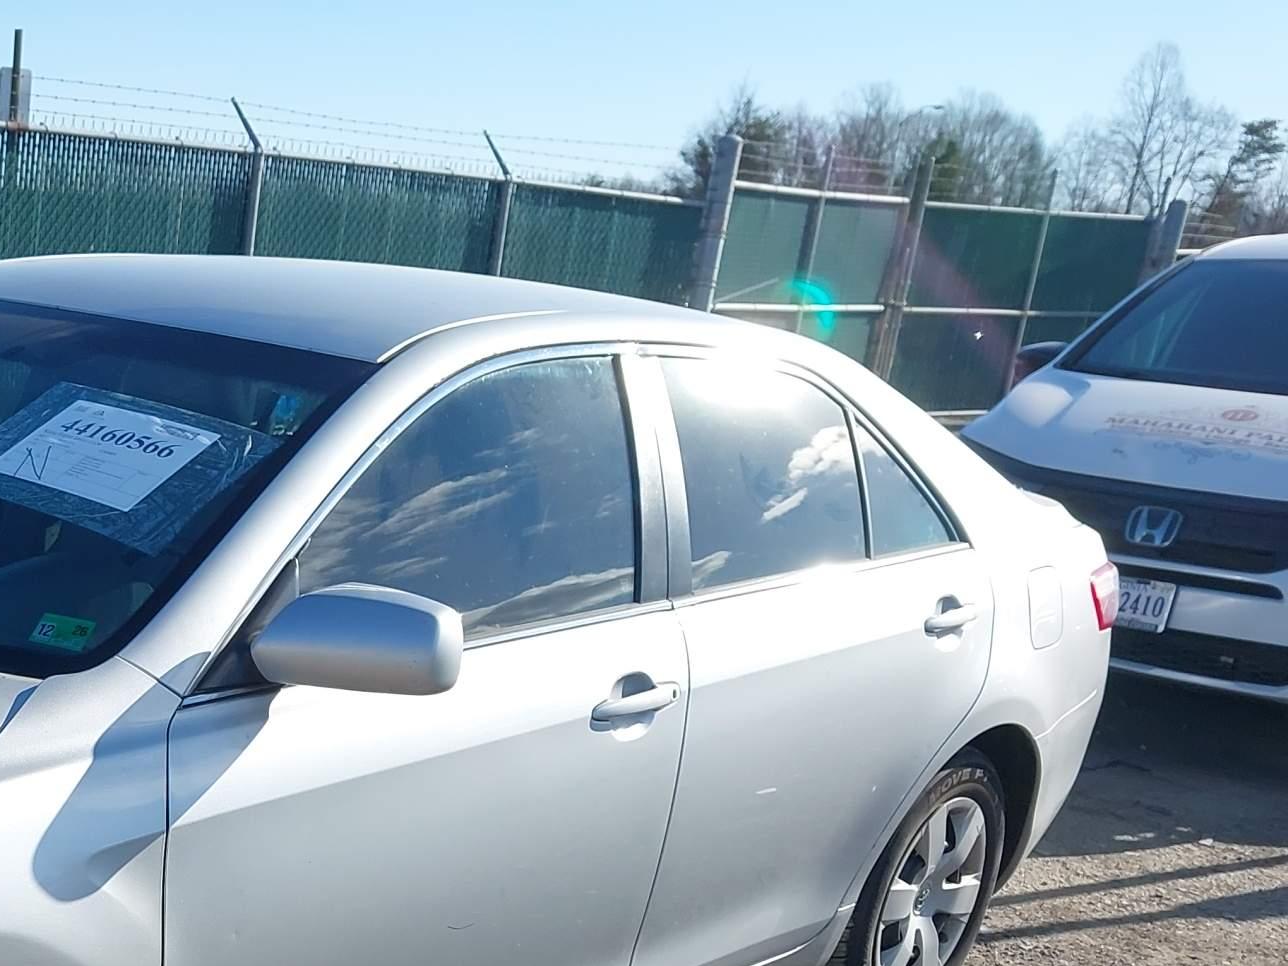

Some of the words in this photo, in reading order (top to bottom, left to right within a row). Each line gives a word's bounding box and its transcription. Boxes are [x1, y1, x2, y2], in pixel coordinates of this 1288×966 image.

[61, 419, 182, 458] 44160566
[1118, 591, 1165, 618] 2410
[38, 623, 55, 637] 12
